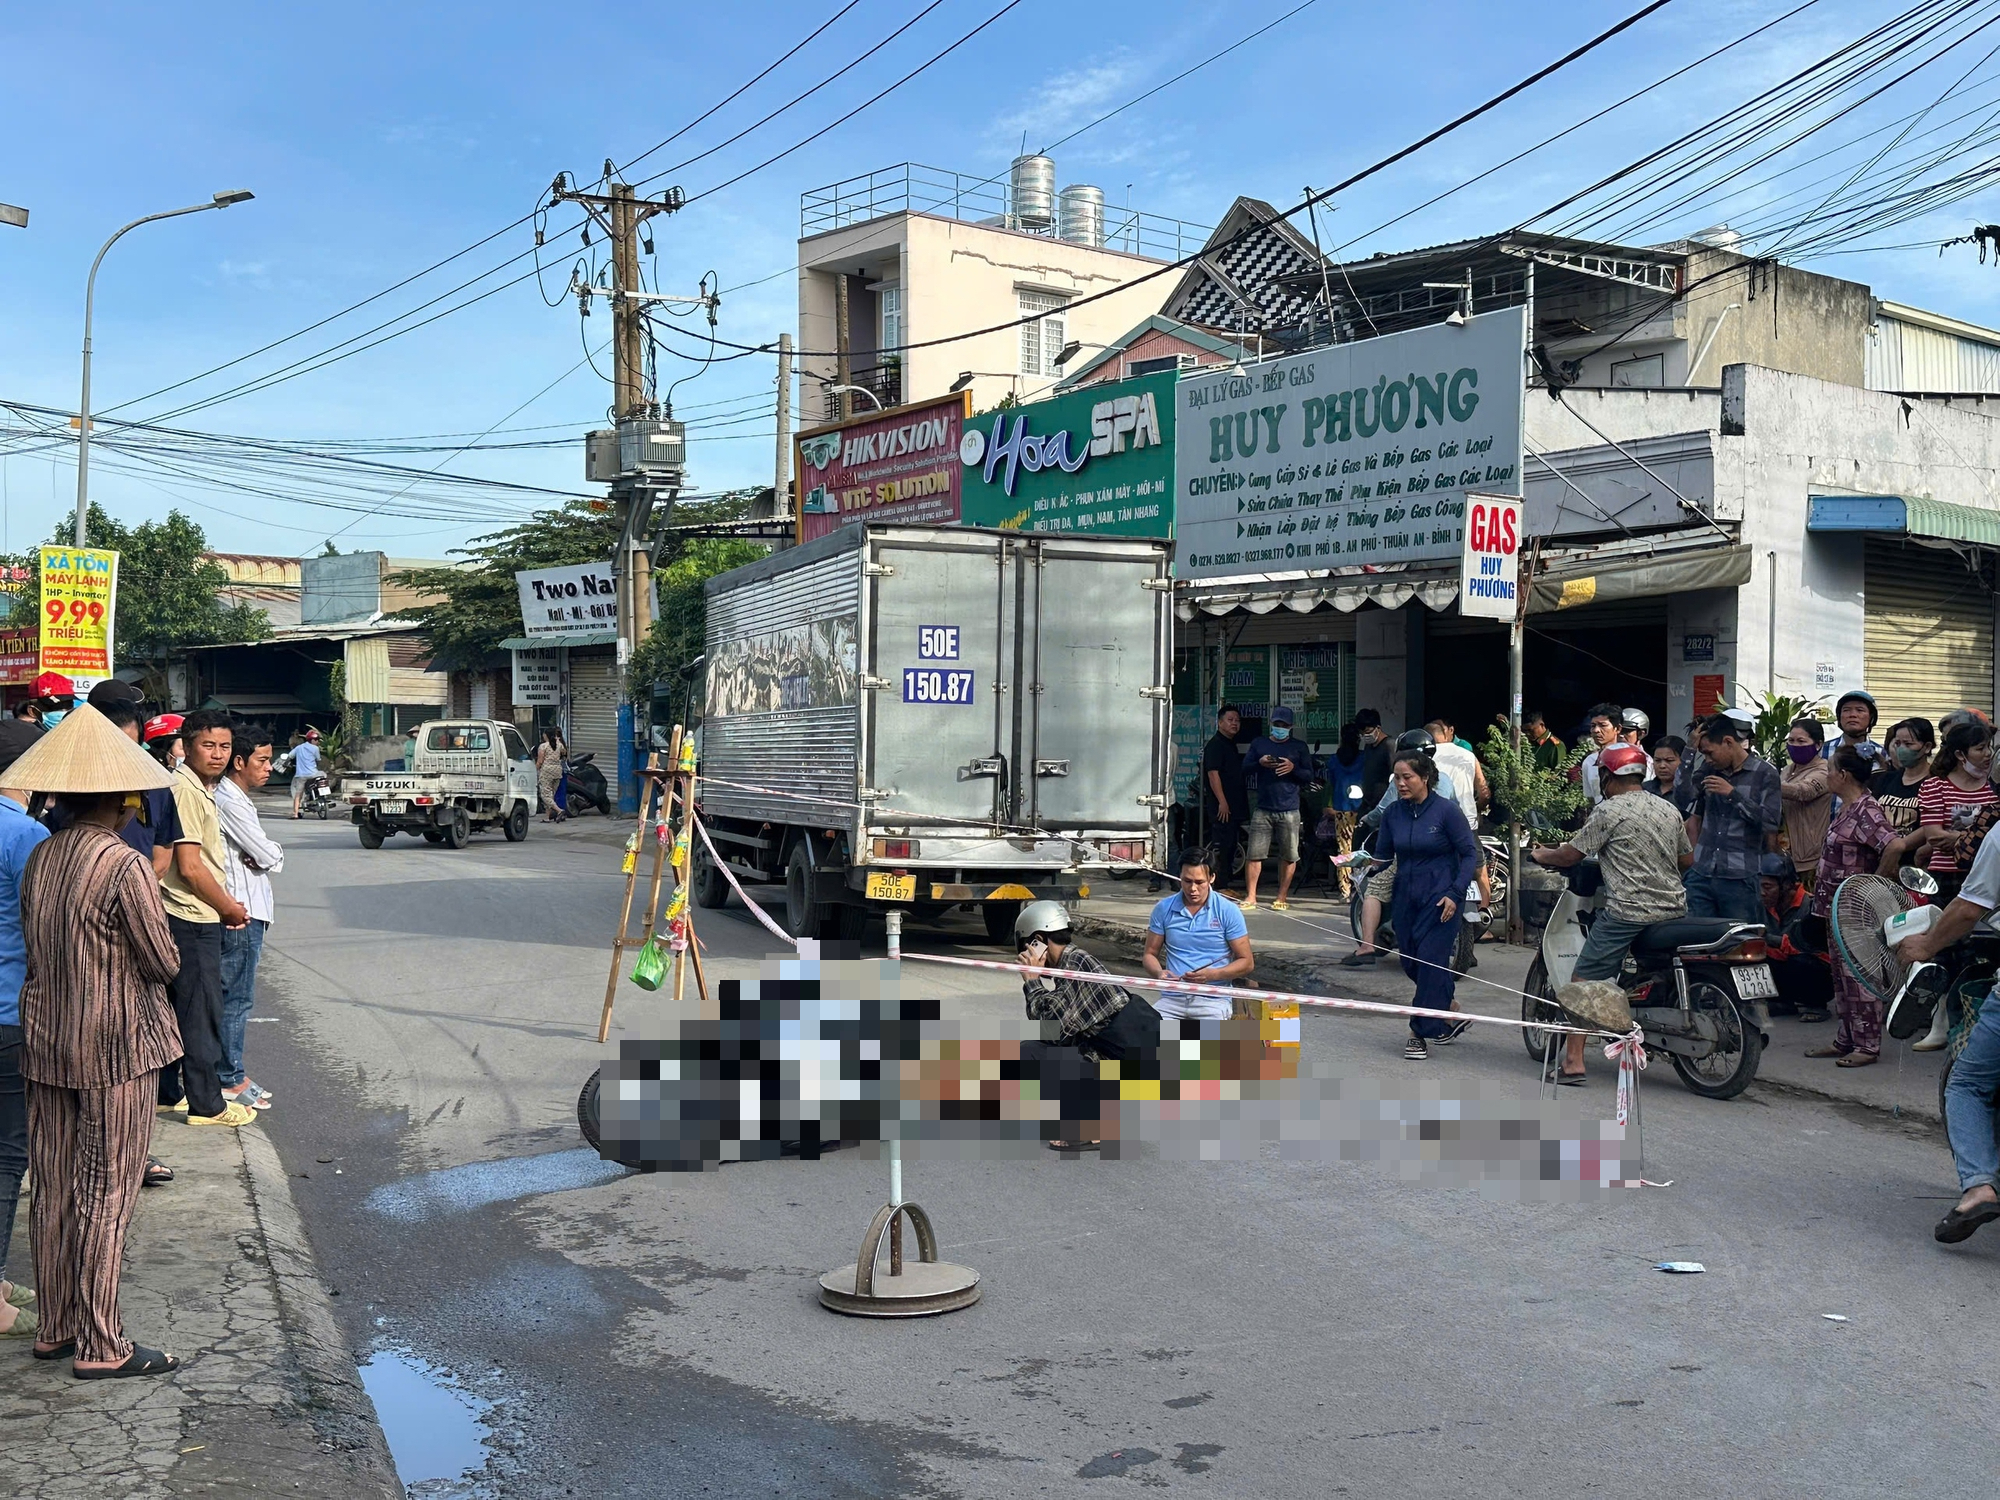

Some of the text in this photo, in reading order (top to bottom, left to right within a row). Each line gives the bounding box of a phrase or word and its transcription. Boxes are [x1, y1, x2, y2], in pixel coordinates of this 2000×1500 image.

[1229, 376, 1253, 399] GAS
[1262, 363, 1285, 393] BẾP
[1289, 363, 1315, 387] GAS
[1091, 392, 1161, 457] SPA
[1209, 367, 1480, 463] HUY PHƯƠNG
[843, 417, 949, 467] HIKVISION
[984, 414, 1091, 496] Hoa
[1249, 472, 1271, 490] Cung
[1342, 459, 1361, 474] Gas
[1411, 448, 1431, 463] Gas
[875, 471, 950, 504] SOLUTION
[1435, 473, 1456, 489] Gas
[1075, 492, 1094, 506] PHUN
[1134, 504, 1159, 520] NHANG
[1411, 503, 1431, 518] Gas
[1414, 532, 1425, 546] AN
[1470, 504, 1516, 555] GAS
[1481, 556, 1503, 575] HUY
[45, 572, 74, 585] MÁY
[76, 575, 108, 588] LẠNH
[532, 574, 618, 601] Two Na
[1469, 577, 1515, 599] PHƯƠNG
[72, 590, 107, 600] Inverter
[45, 599, 104, 627] 9,99
[47, 625, 84, 642] TRIỆU
[920, 628, 957, 658] 50E
[1686, 637, 1713, 650] 282/2
[905, 672, 971, 701] 150.87
[881, 875, 902, 886] 50E
[872, 886, 909, 899] 150.87
